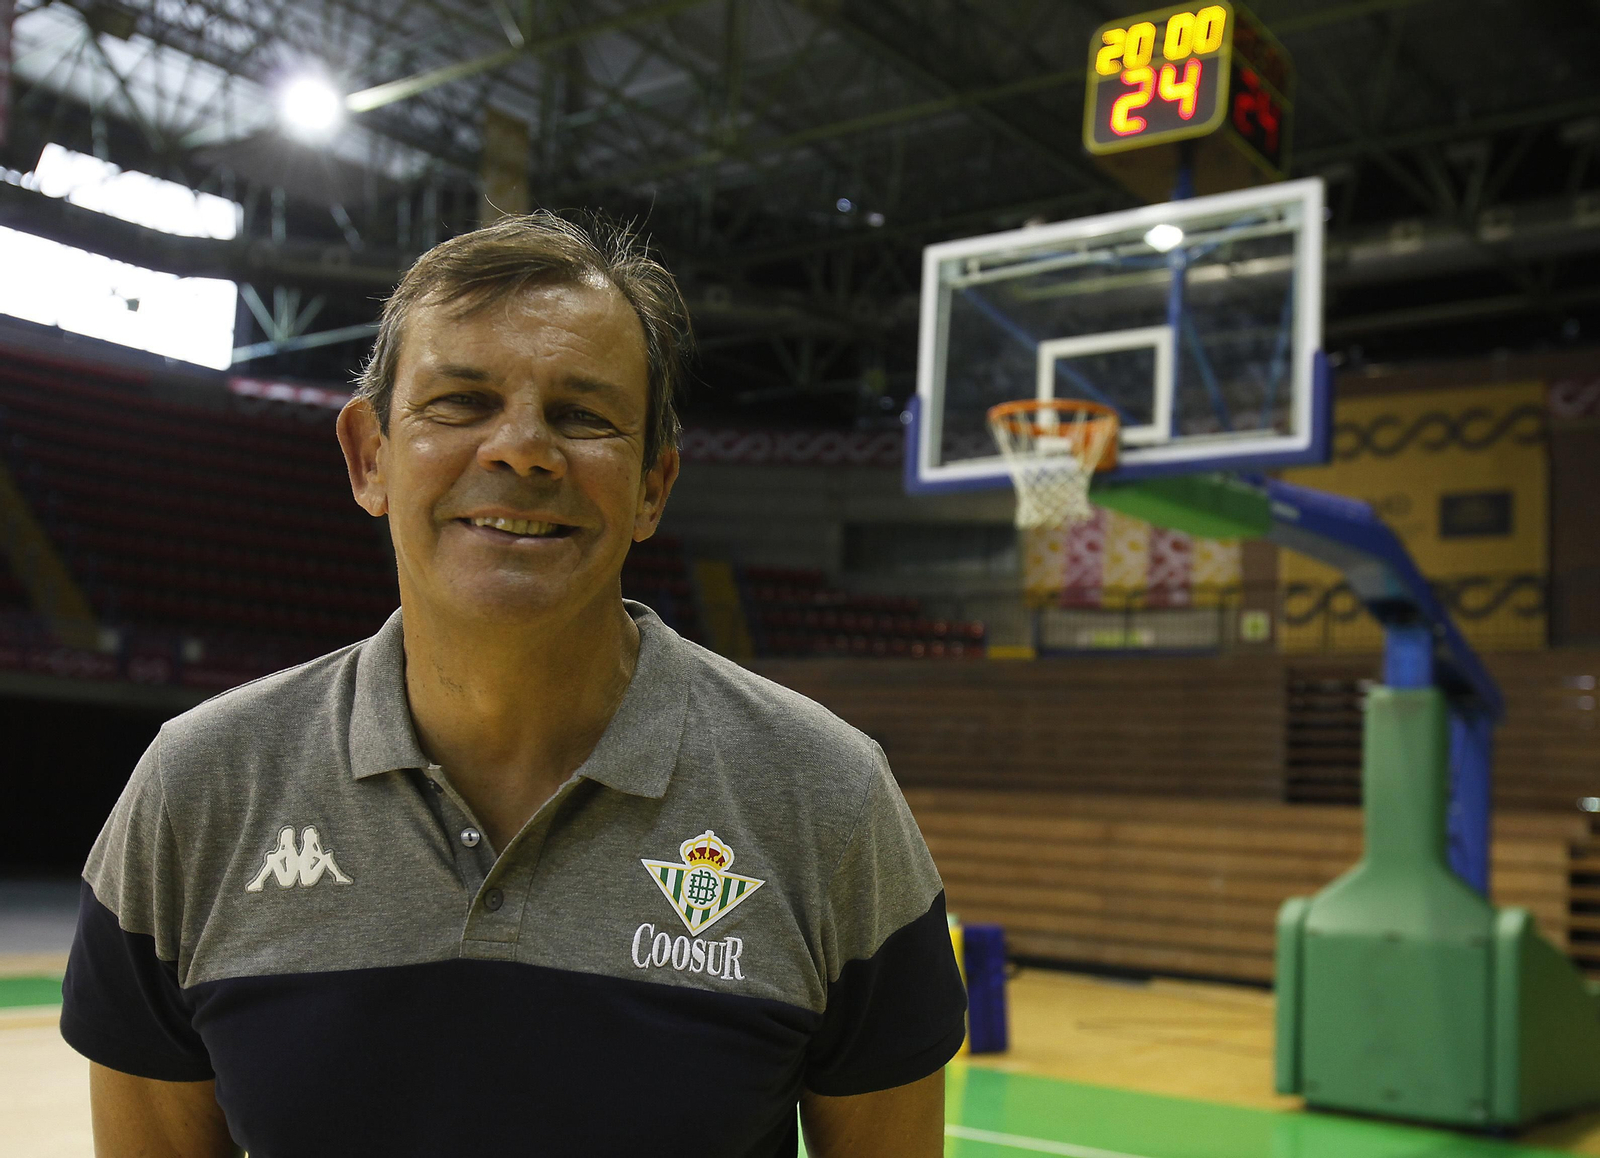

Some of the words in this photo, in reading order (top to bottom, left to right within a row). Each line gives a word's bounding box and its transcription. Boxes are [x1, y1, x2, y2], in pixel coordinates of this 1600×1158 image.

[1096, 22, 1156, 75] 20
[1164, 6, 1226, 60] 00
[1111, 59, 1202, 136] 24
